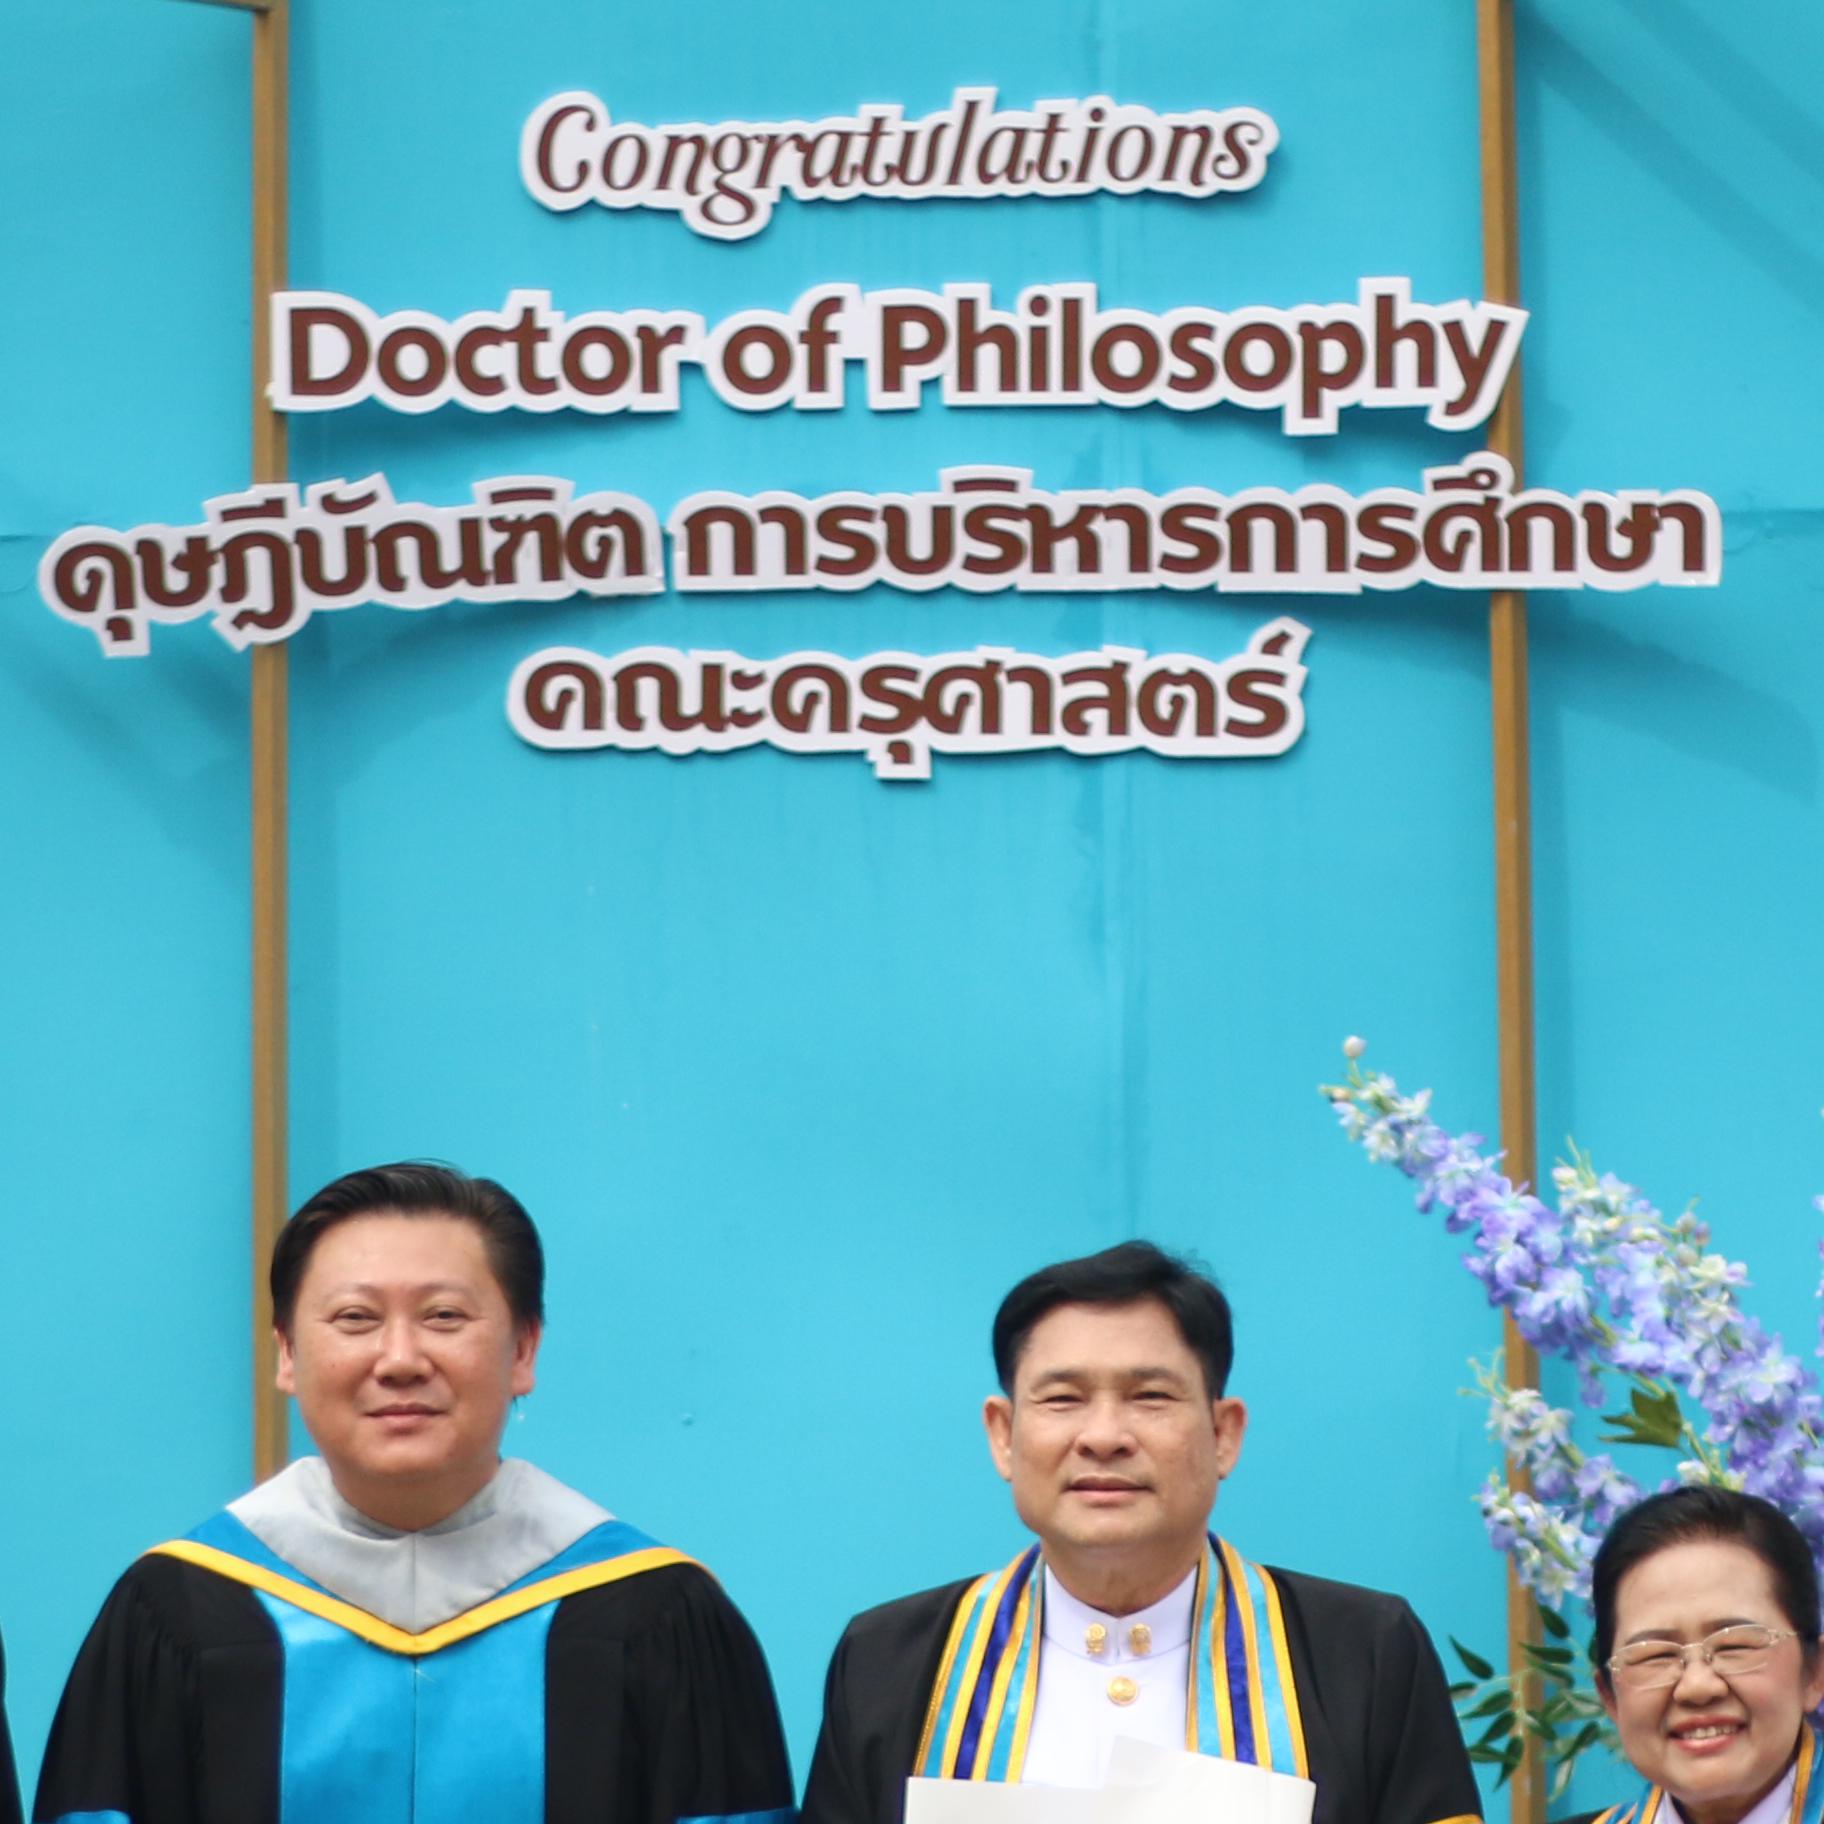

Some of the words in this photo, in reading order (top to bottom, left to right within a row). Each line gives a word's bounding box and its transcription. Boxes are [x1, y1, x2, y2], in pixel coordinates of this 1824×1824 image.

[537, 100, 1263, 221] Congratulations
[288, 300, 681, 398] Doctor
[723, 297, 844, 397] of
[881, 296, 1510, 419] Philosophy
[56, 488, 645, 643] ดุษฎีบัณฑิต
[686, 466, 1706, 578] การบริหารการศึกษา
[526, 634, 1290, 766] คณะครุศาสตร์
